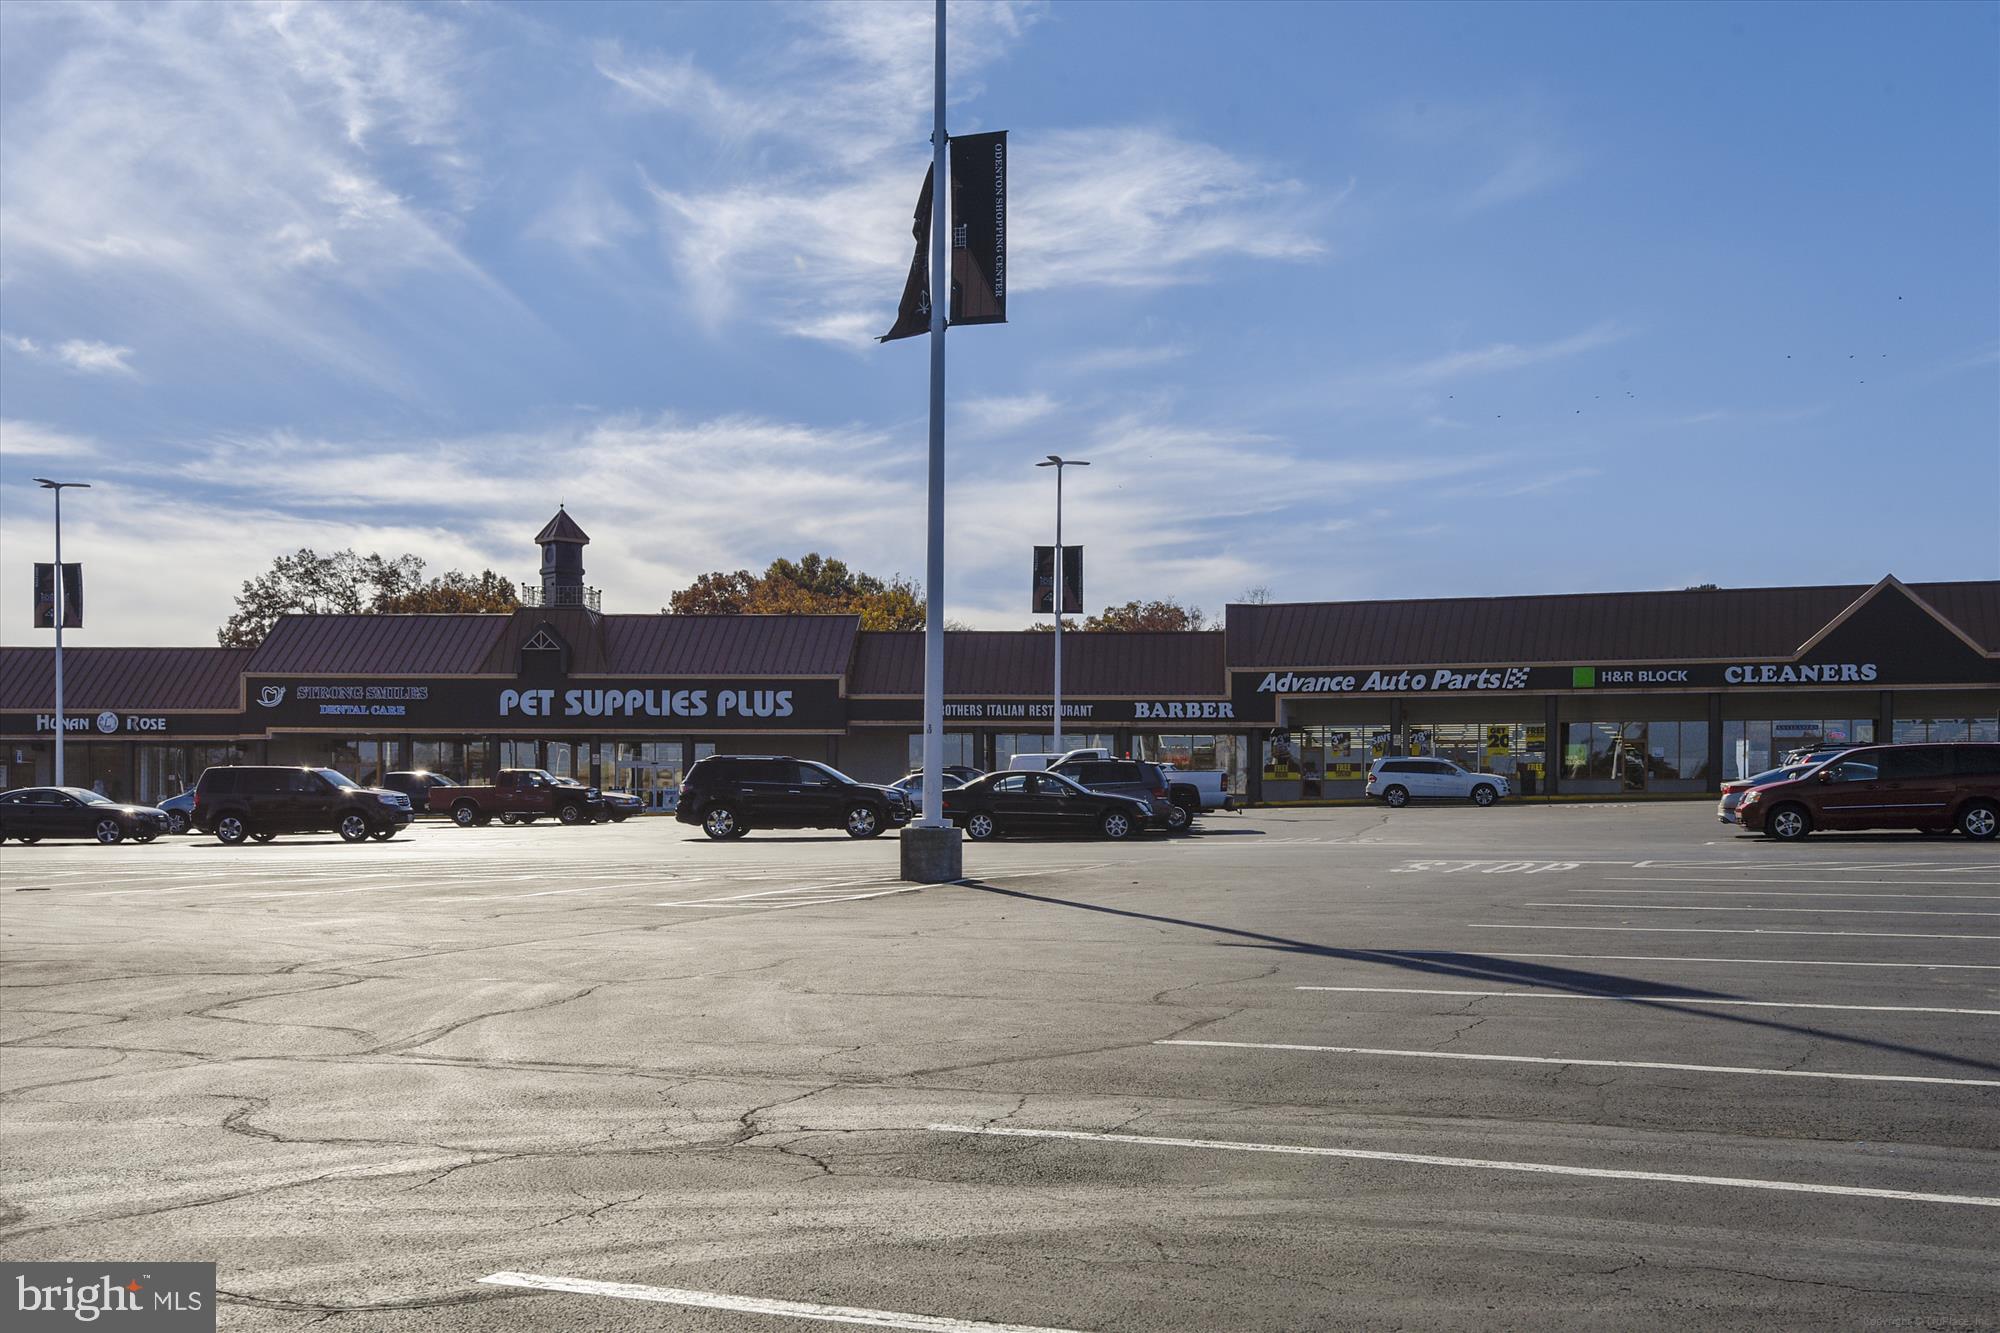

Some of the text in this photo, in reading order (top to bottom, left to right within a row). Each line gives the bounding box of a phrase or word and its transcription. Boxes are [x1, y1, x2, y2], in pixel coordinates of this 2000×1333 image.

[994, 143, 1004, 298] ODENTON SHOPPING CENTER
[1602, 670, 1688, 682] H&R BLOCK
[1725, 663, 1877, 683] CLEANERS
[1257, 668, 1501, 693] Advance Auto Parts
[296, 686, 428, 700] STRONG SMILES
[320, 705, 406, 715] DENTAL CARE
[499, 689, 793, 717] PET SUPPLIES PLUS
[987, 704, 1025, 716] ITALIAN
[1029, 704, 1093, 717] RESTURANT
[1134, 702, 1234, 719] BARBER
[1488, 734, 1509, 748] 20
[1389, 860, 1580, 874] STOP
